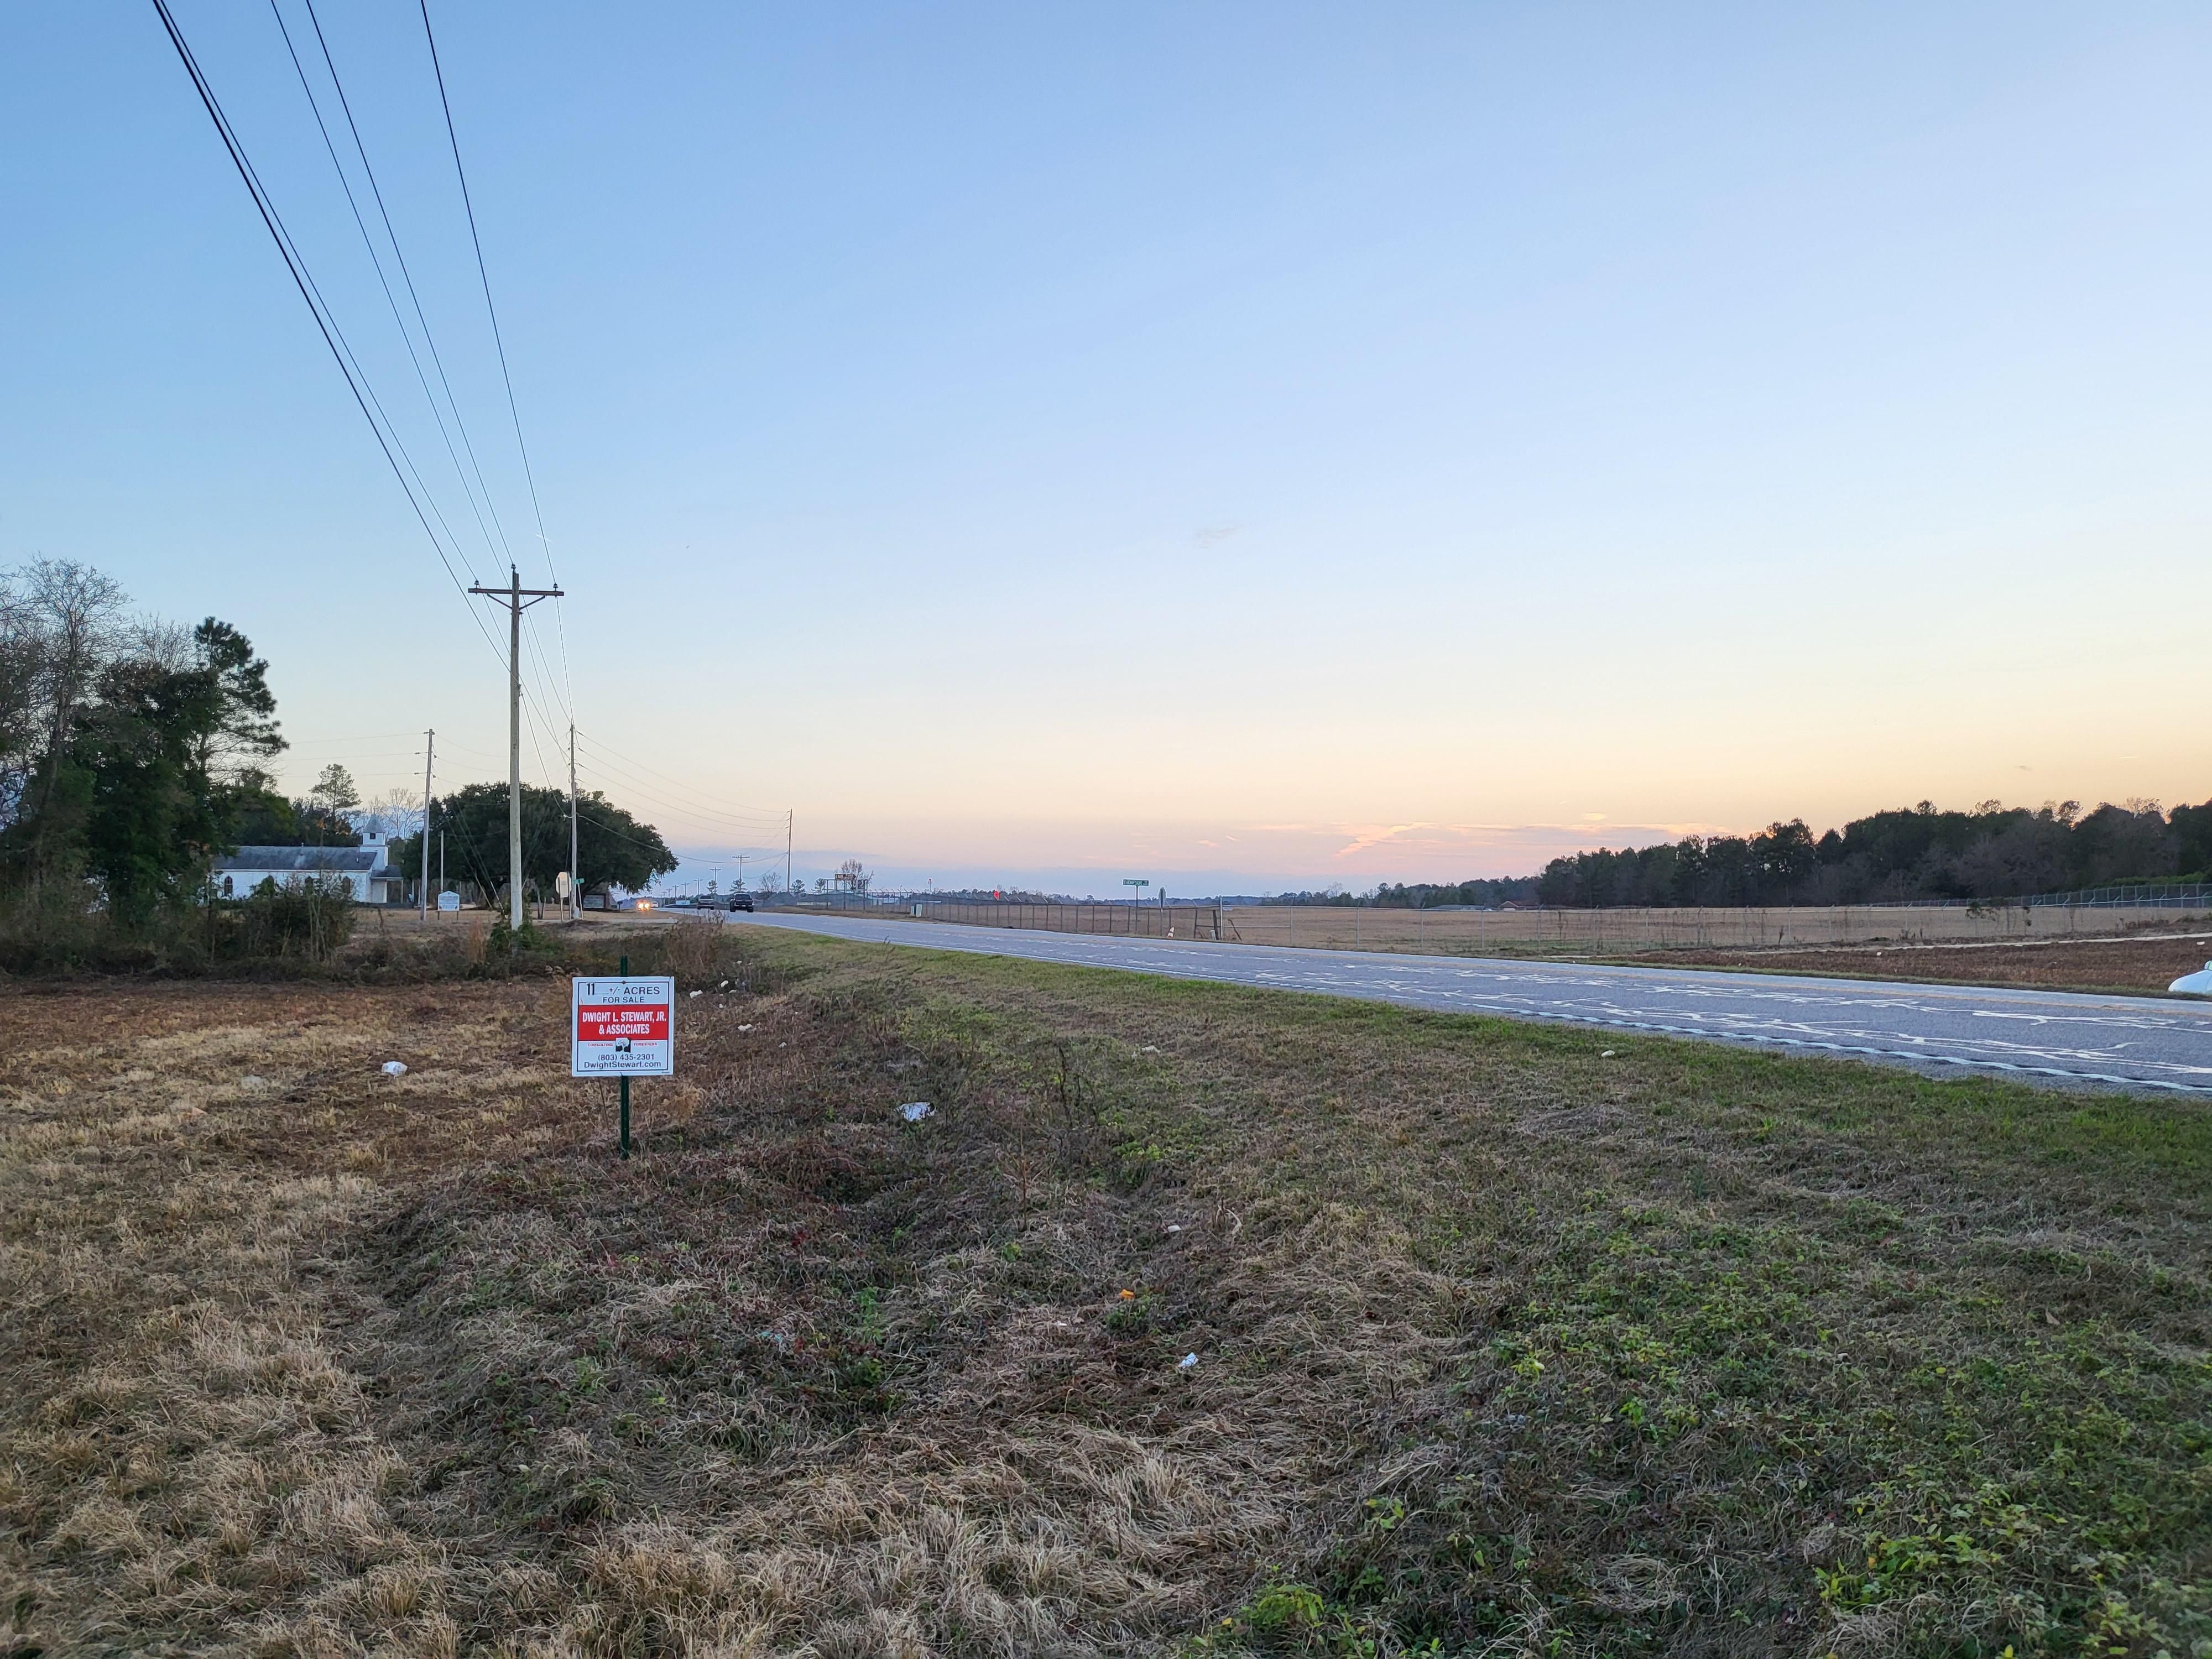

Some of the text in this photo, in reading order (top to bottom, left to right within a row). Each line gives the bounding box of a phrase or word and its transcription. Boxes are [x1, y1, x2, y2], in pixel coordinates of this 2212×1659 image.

[587, 983, 594, 995] 11
[623, 987, 660, 995] ACRES
[582, 1011, 666, 1023] DWIGHT L. STEWART, JR.
[598, 1024, 650, 1035] & ASSOCIATES
[584, 1061, 661, 1070] DwightStewart.com
